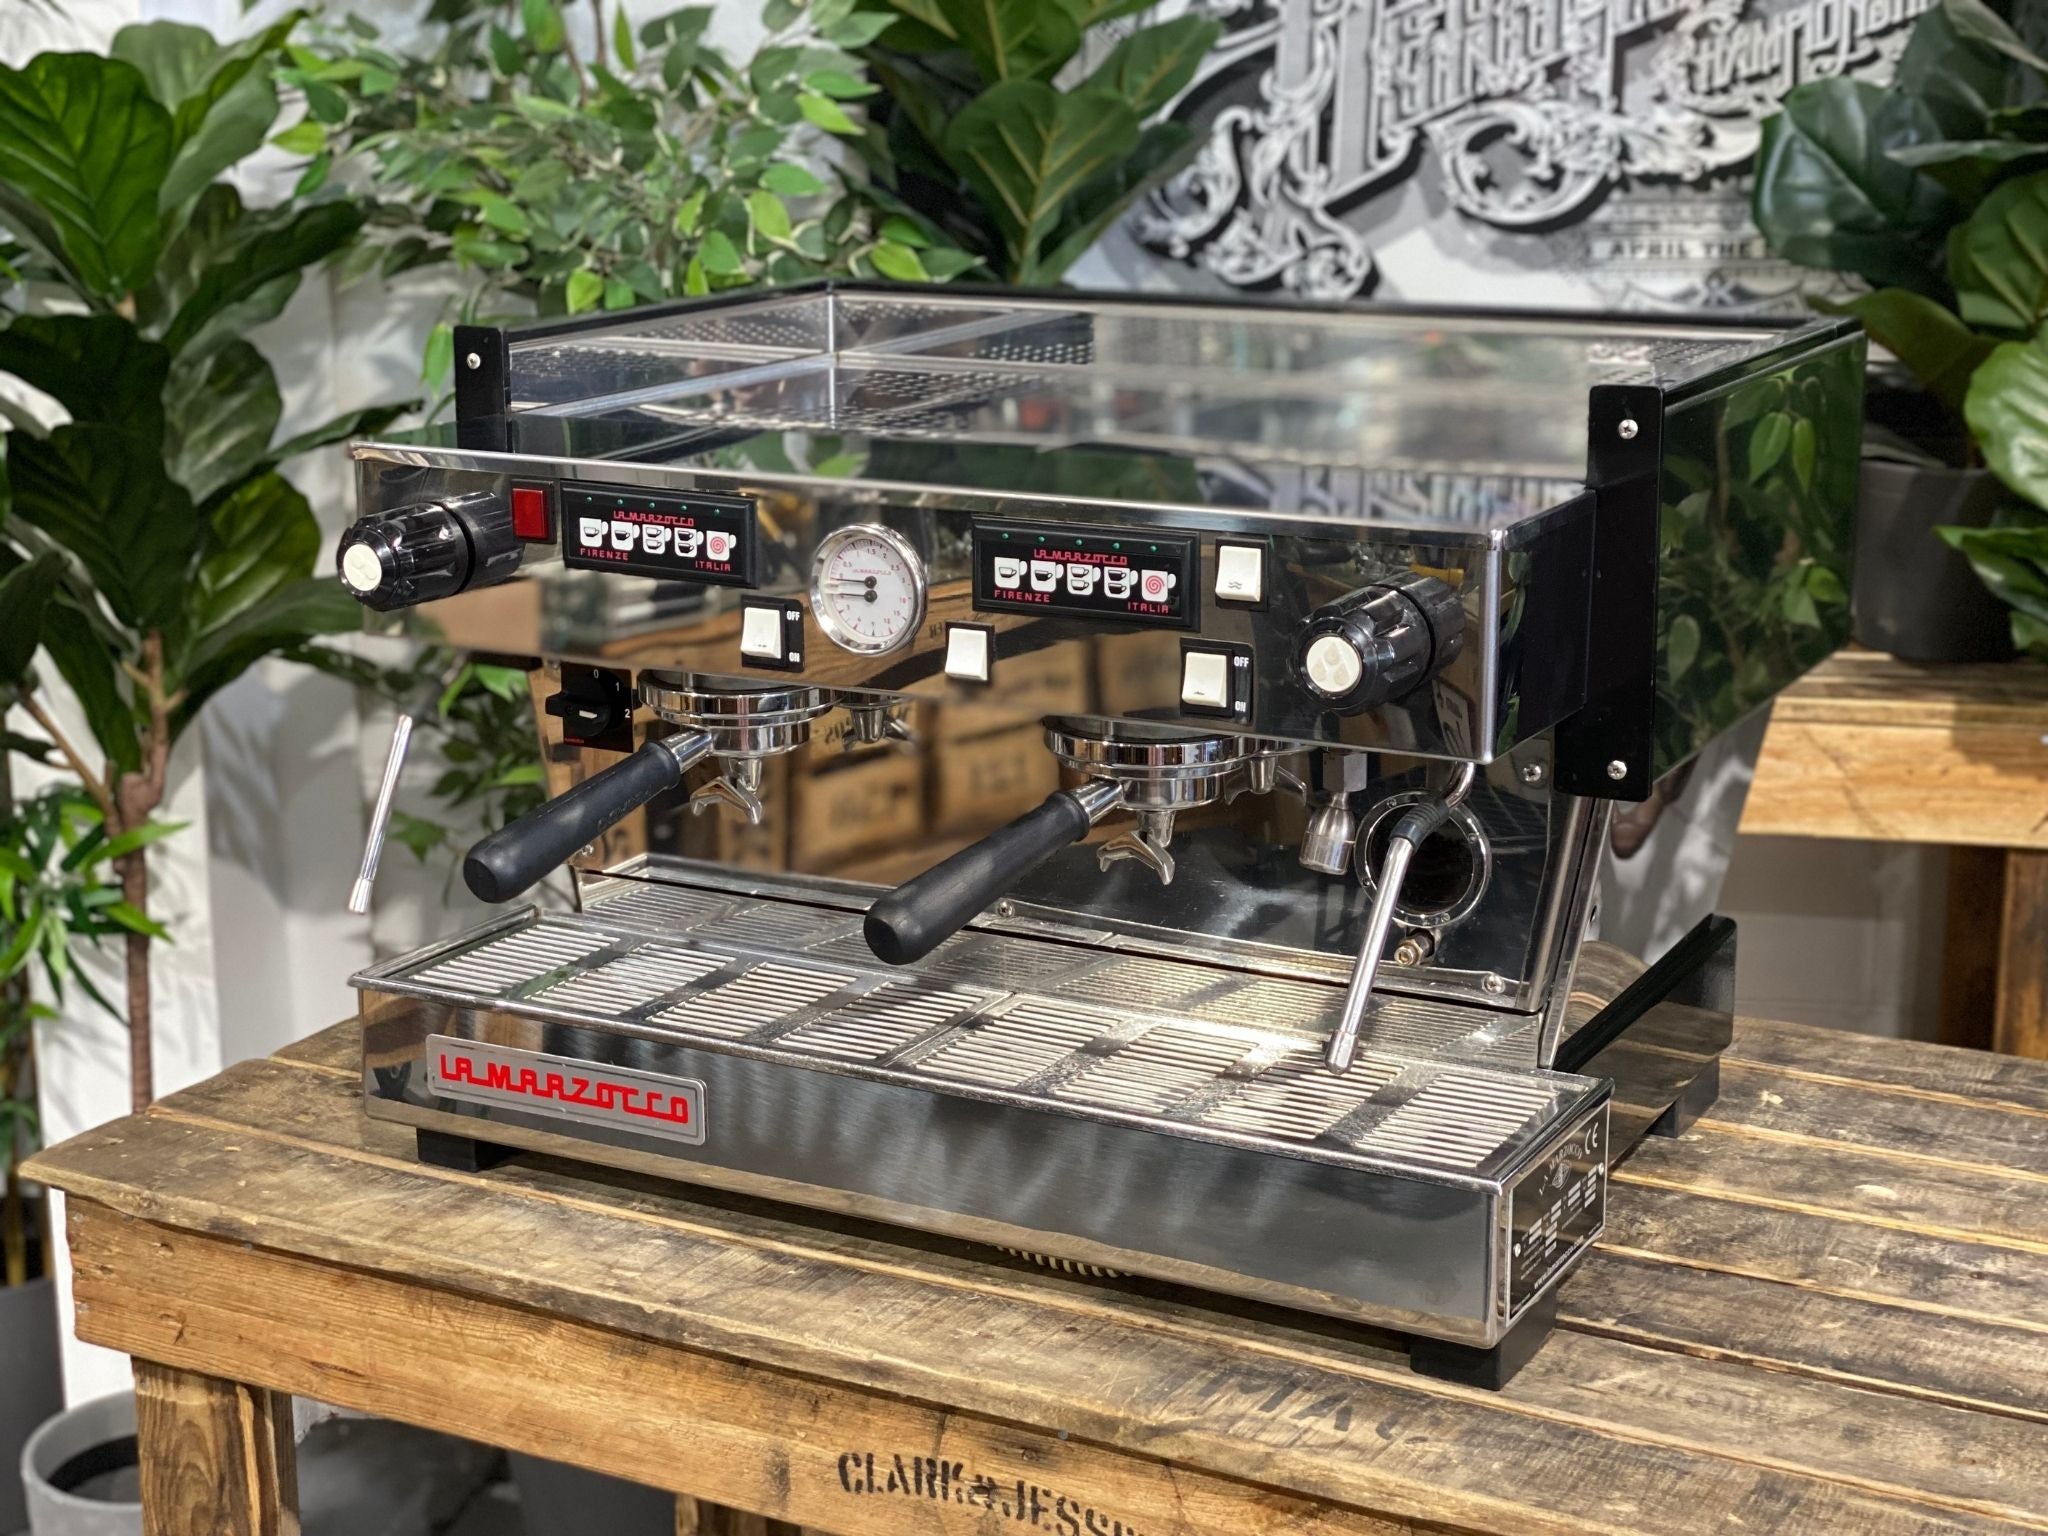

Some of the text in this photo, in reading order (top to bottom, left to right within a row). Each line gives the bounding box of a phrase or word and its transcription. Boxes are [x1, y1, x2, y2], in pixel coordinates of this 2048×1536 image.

[1611, 241, 1748, 259] APRIL THE
[579, 547, 629, 561] FIRENZE
[695, 560, 731, 572] ITALIA
[994, 589, 1051, 603] FIRENZE
[1127, 601, 1169, 614] ITALIA
[786, 610, 800, 621] OFF
[789, 652, 800, 663] ON
[1233, 656, 1249, 667] OFF
[1234, 700, 1246, 712] ON
[624, 708, 631, 718] 2
[487, 1062, 688, 1124] MARZOCCO
[837, 1452, 964, 1504] CLARK
